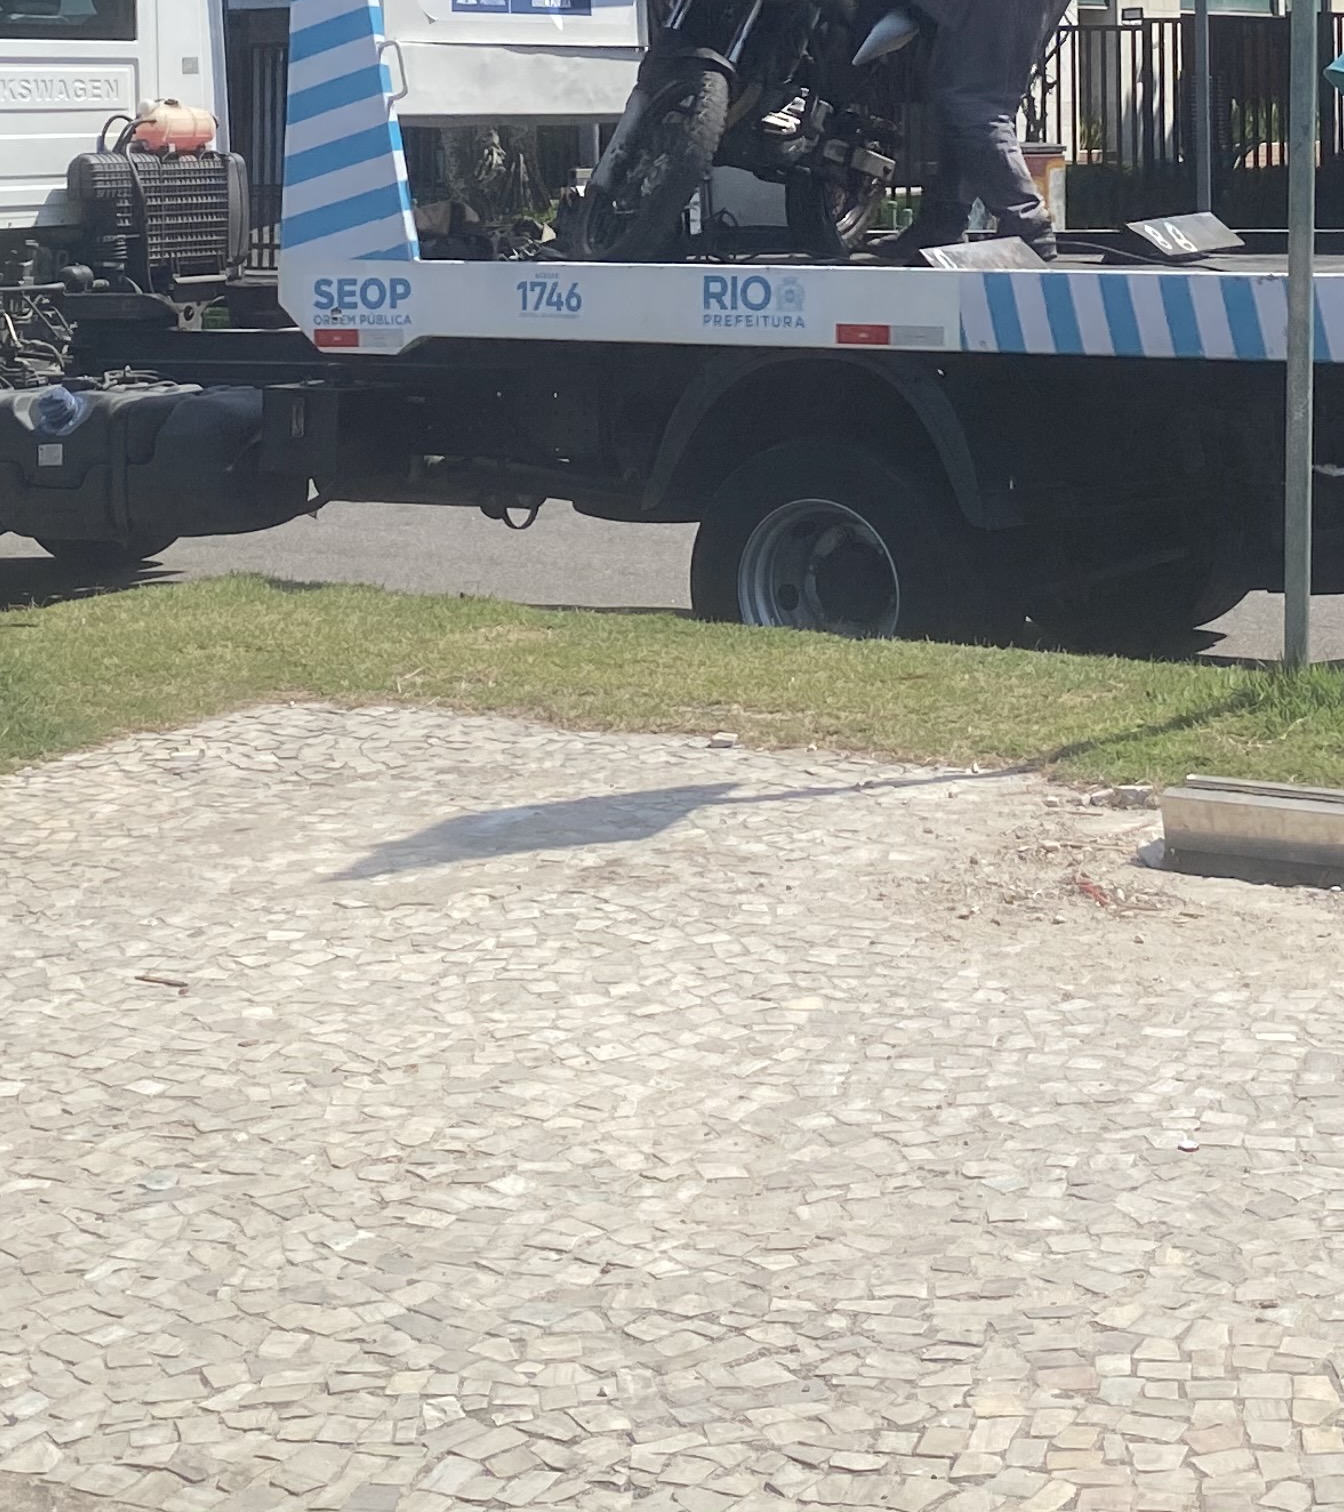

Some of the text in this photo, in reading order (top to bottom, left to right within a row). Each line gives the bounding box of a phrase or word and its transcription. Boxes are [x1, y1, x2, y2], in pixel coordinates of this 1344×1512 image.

[313, 277, 412, 310] SEOP
[516, 281, 583, 313] 1746
[703, 275, 772, 311] RIO
[313, 311, 412, 326] ORDEM PÚBLICA
[702, 313, 806, 329] PREFEITURA
